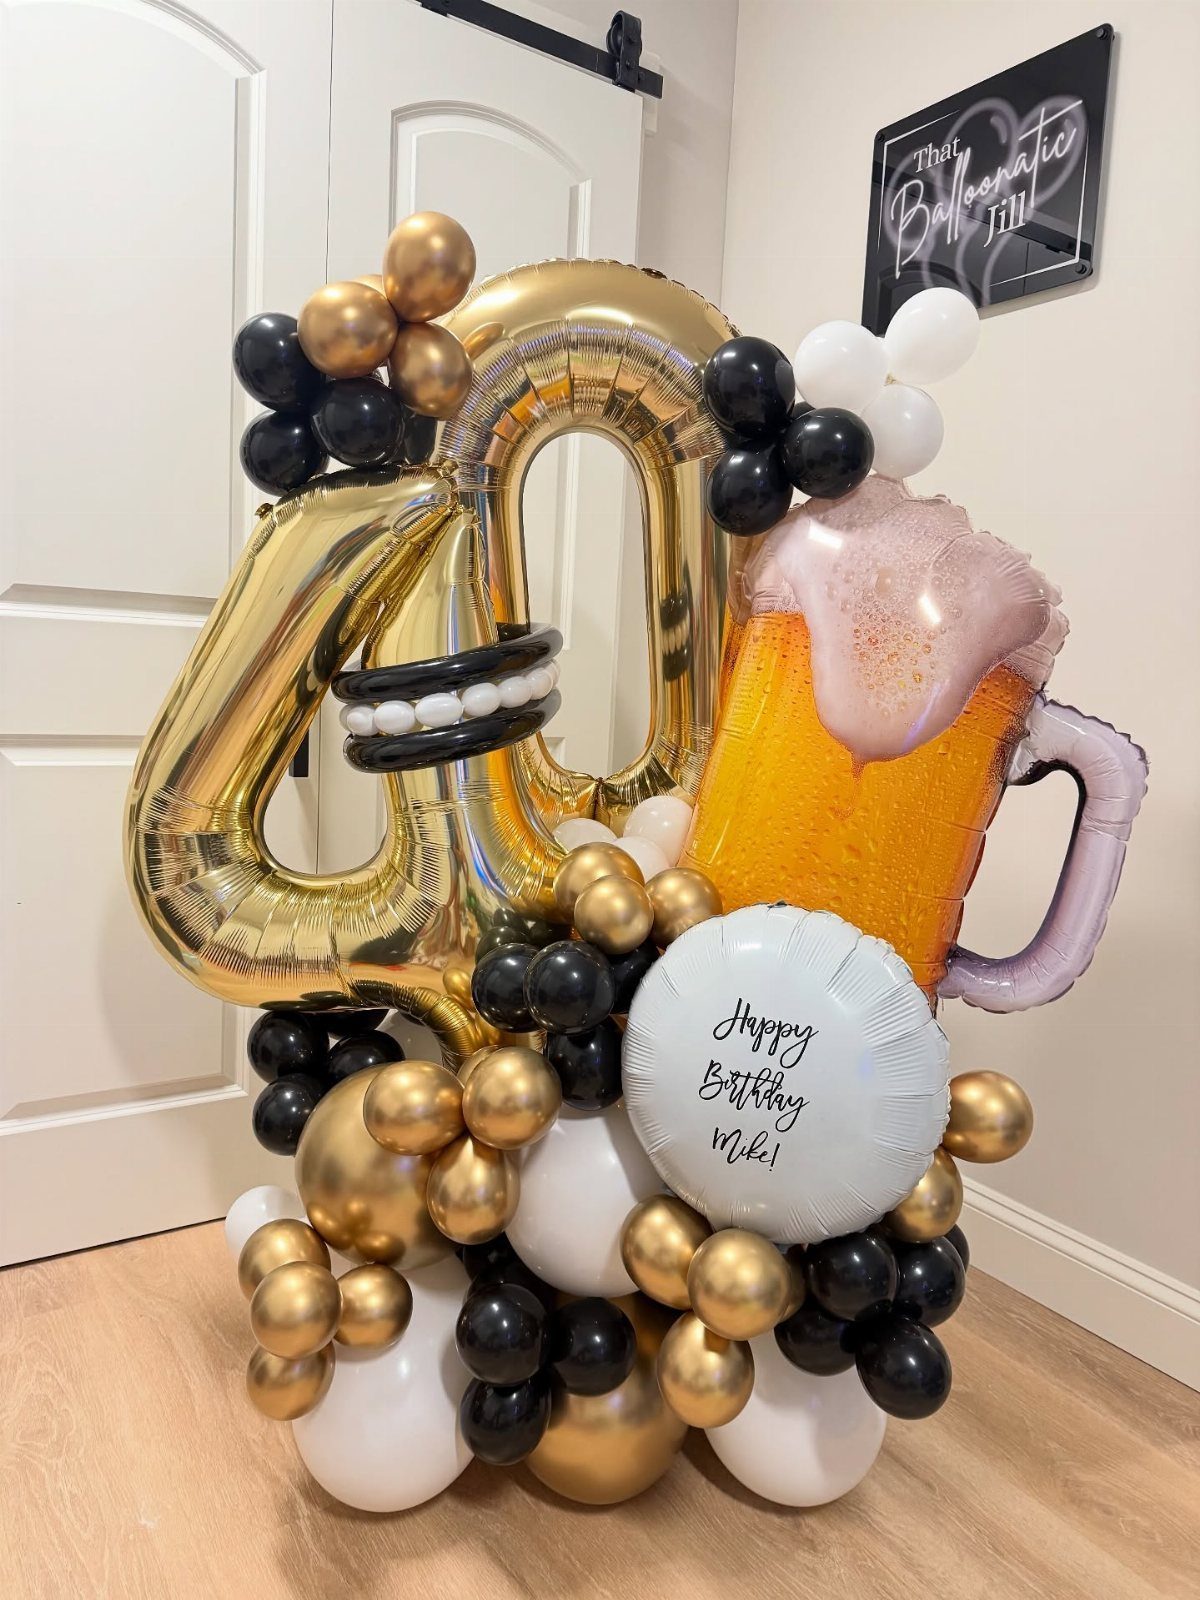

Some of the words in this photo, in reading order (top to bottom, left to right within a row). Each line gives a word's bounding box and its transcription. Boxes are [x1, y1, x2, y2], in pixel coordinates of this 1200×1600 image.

[913, 136, 961, 173] That
[890, 99, 1083, 280] Balloonatic
[983, 190, 1027, 248] Jill
[712, 997, 820, 1069] Happy
[698, 1059, 811, 1133] Birthday
[712, 1126, 781, 1172] Mike!
